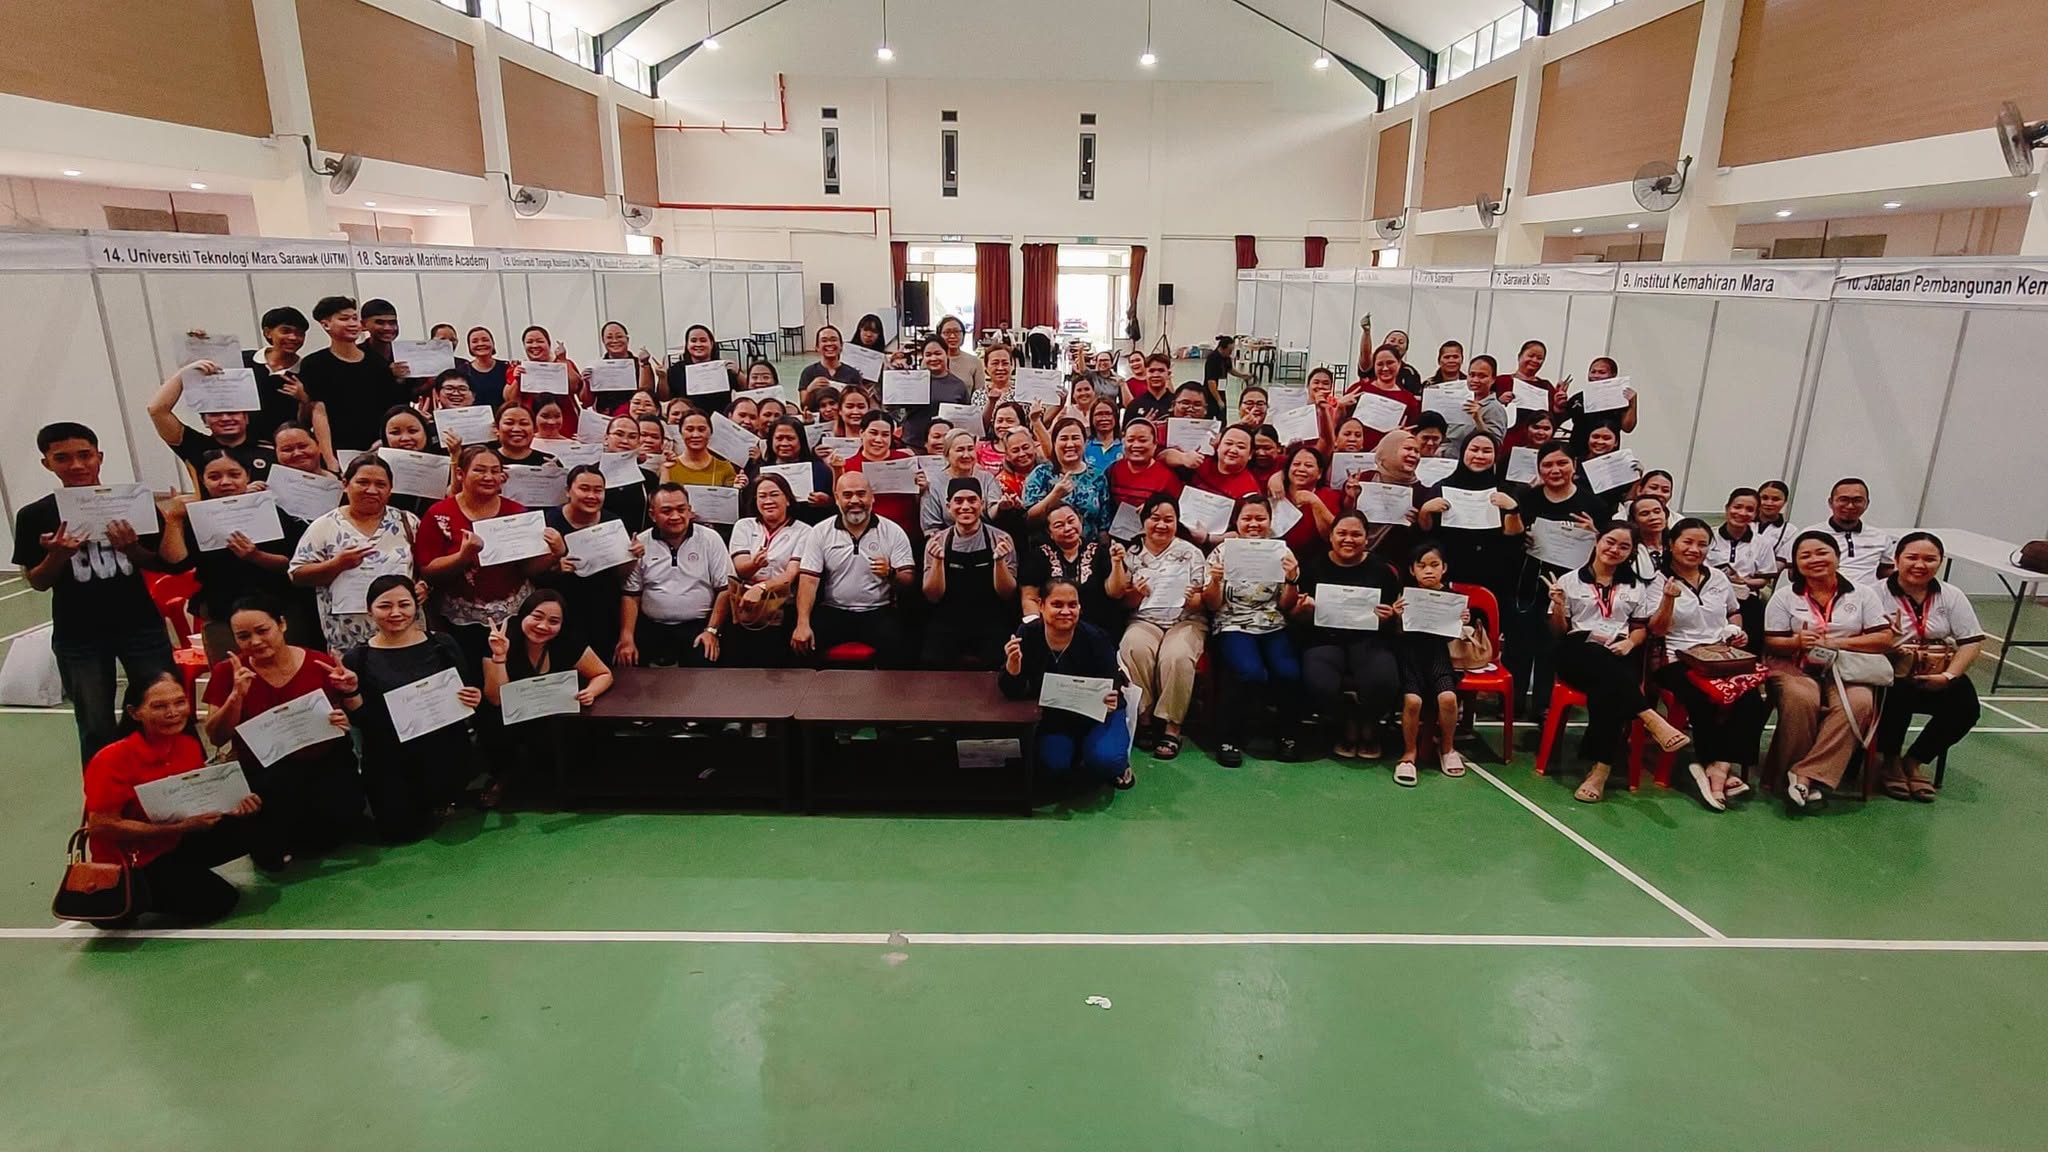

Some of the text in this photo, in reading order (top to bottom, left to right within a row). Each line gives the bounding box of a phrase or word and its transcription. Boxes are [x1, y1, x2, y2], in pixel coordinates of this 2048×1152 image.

[103, 247, 349, 268] 14. Universiti Teknologi Mara Sarawak (UiTM)
[357, 251, 489, 269] 18. Sarawak Maritime Academy
[1503, 273, 1531, 286] Sarawak
[1532, 273, 1550, 285] Skills
[1623, 272, 1774, 292] 9. Institut Kemahiran Mara
[1864, 276, 1910, 292] Jabatan
[1913, 275, 2012, 298] Pembangunan
